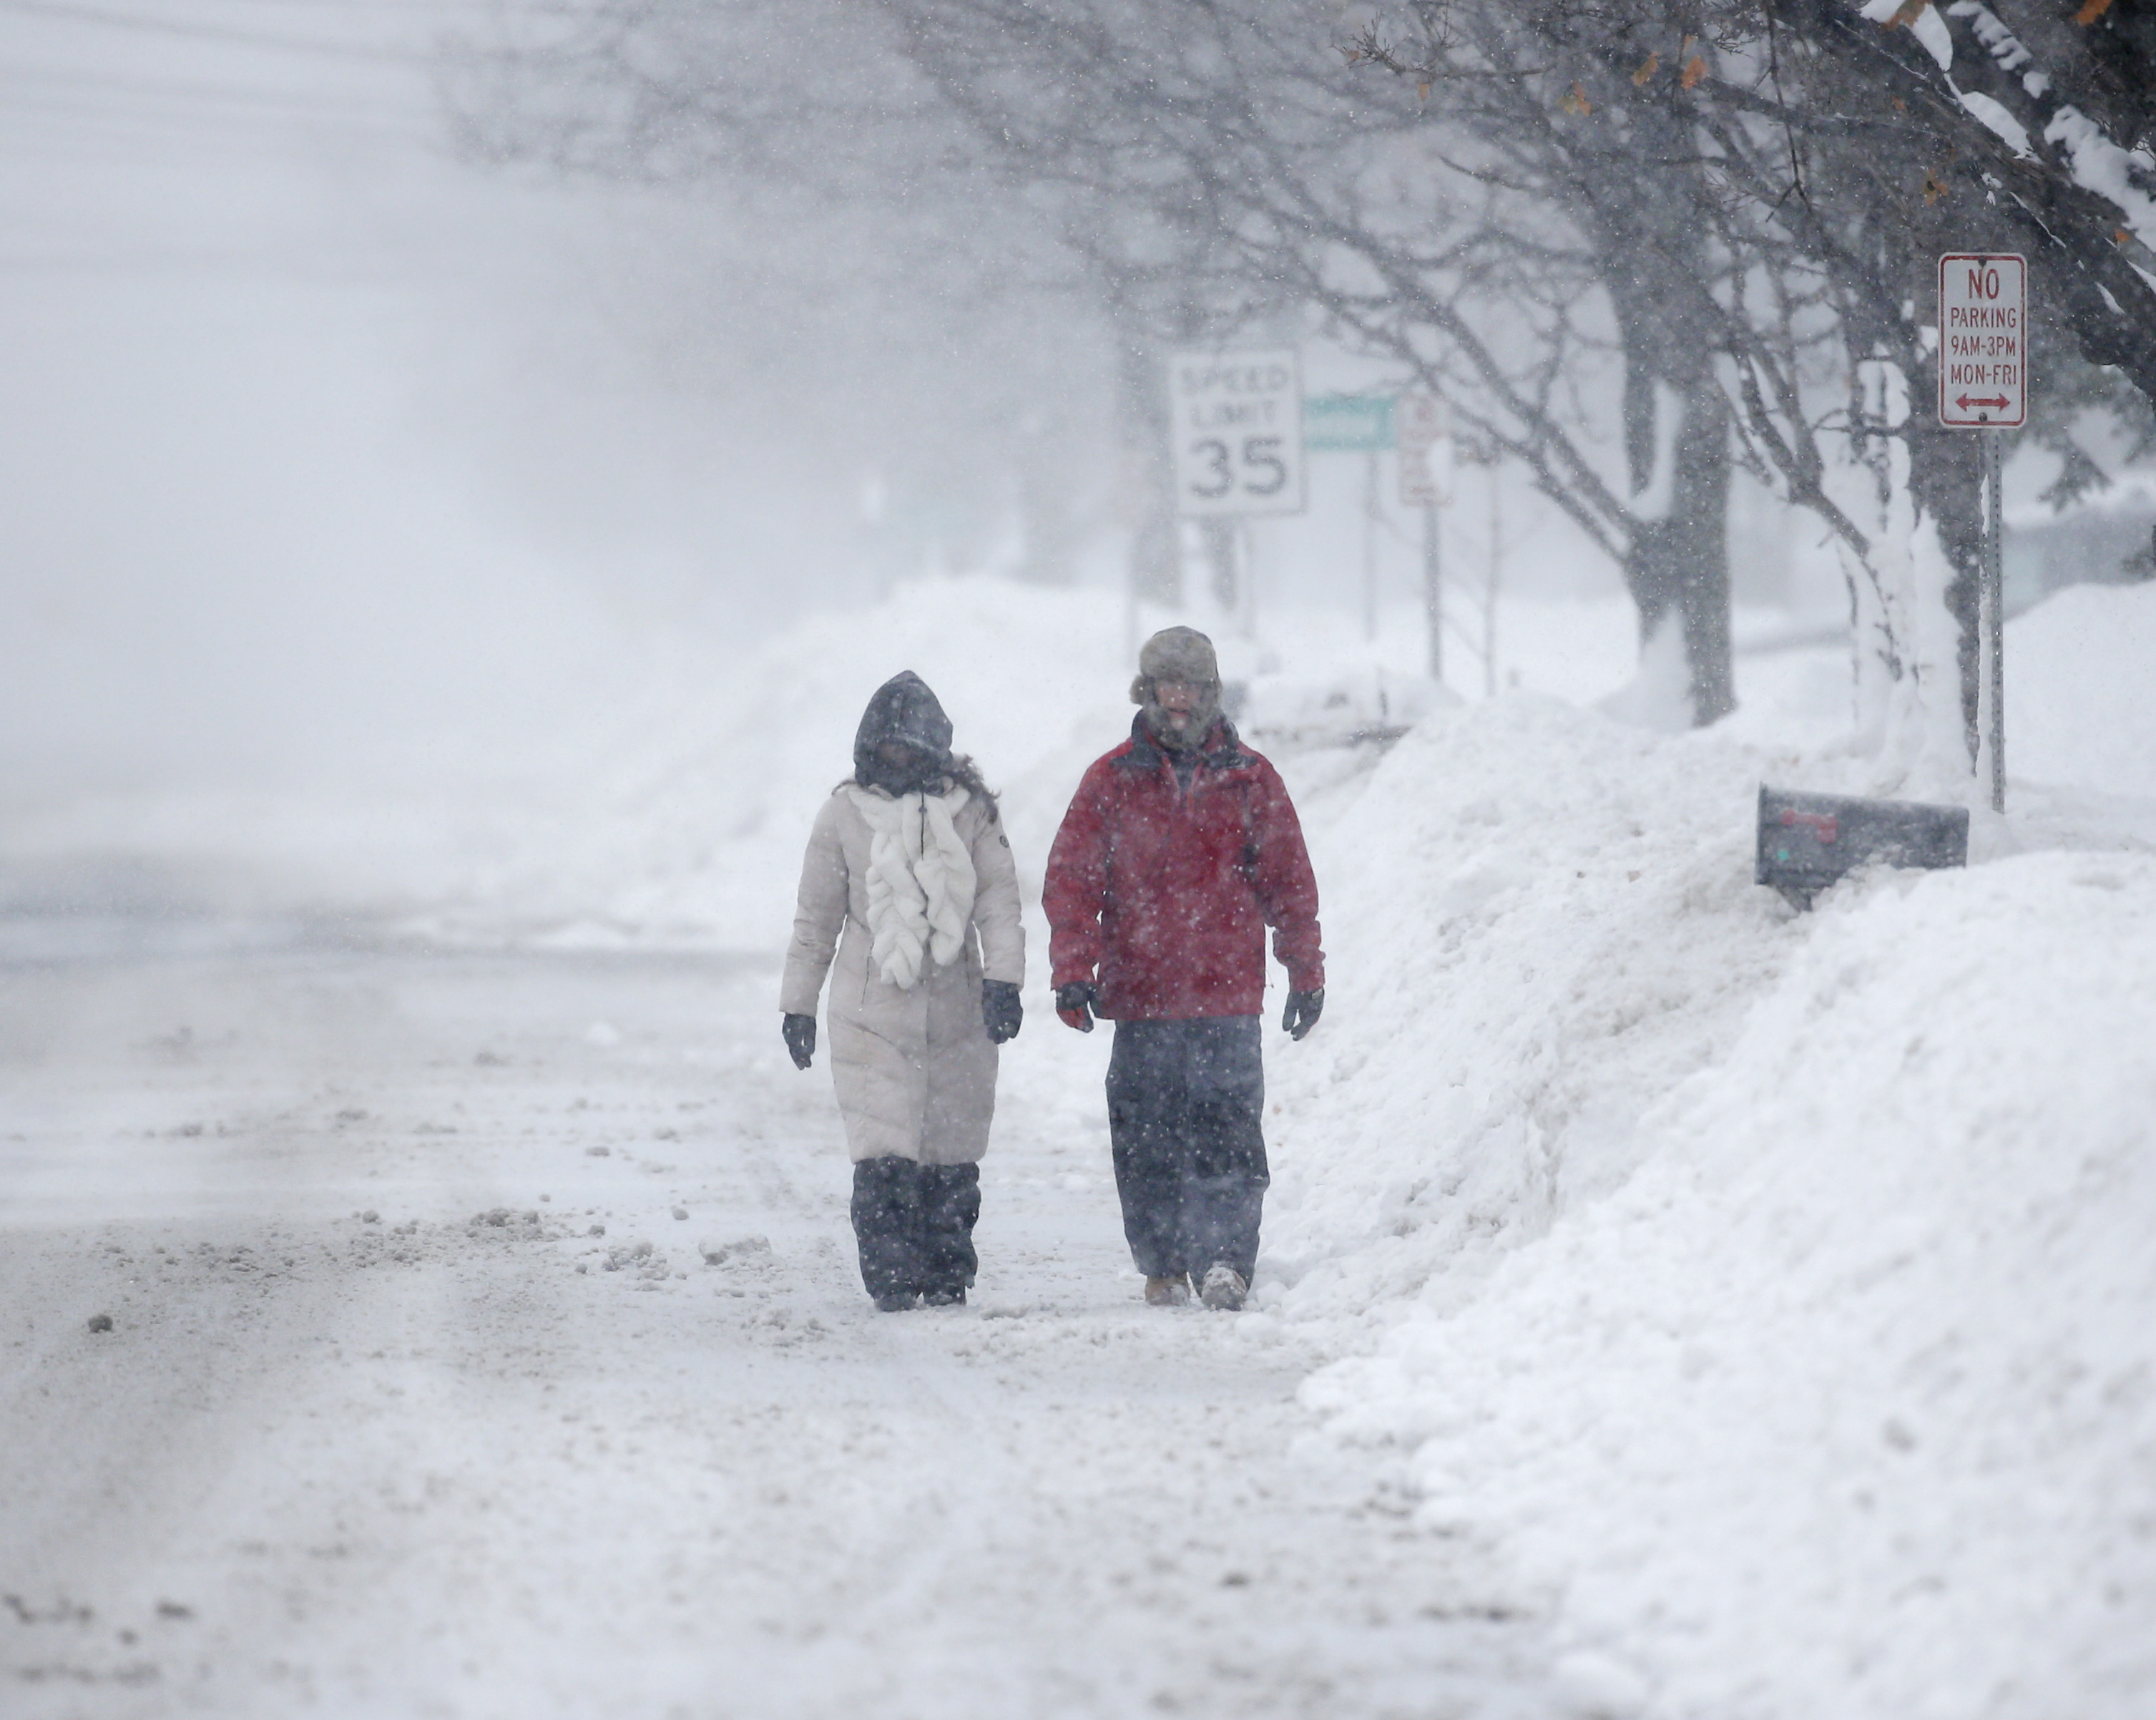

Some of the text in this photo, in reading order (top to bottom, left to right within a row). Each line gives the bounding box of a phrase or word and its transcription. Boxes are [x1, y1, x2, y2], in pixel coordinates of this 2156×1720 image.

[1969, 268, 1999, 300] NO
[1951, 307, 2017, 328] PARKING
[1951, 336, 2017, 357] 9AM-3PM
[1180, 365, 1288, 395] SPEED
[1951, 364, 2017, 385] MON-FRI
[1190, 400, 1277, 429] LIMIT
[1188, 436, 1288, 499] 35
